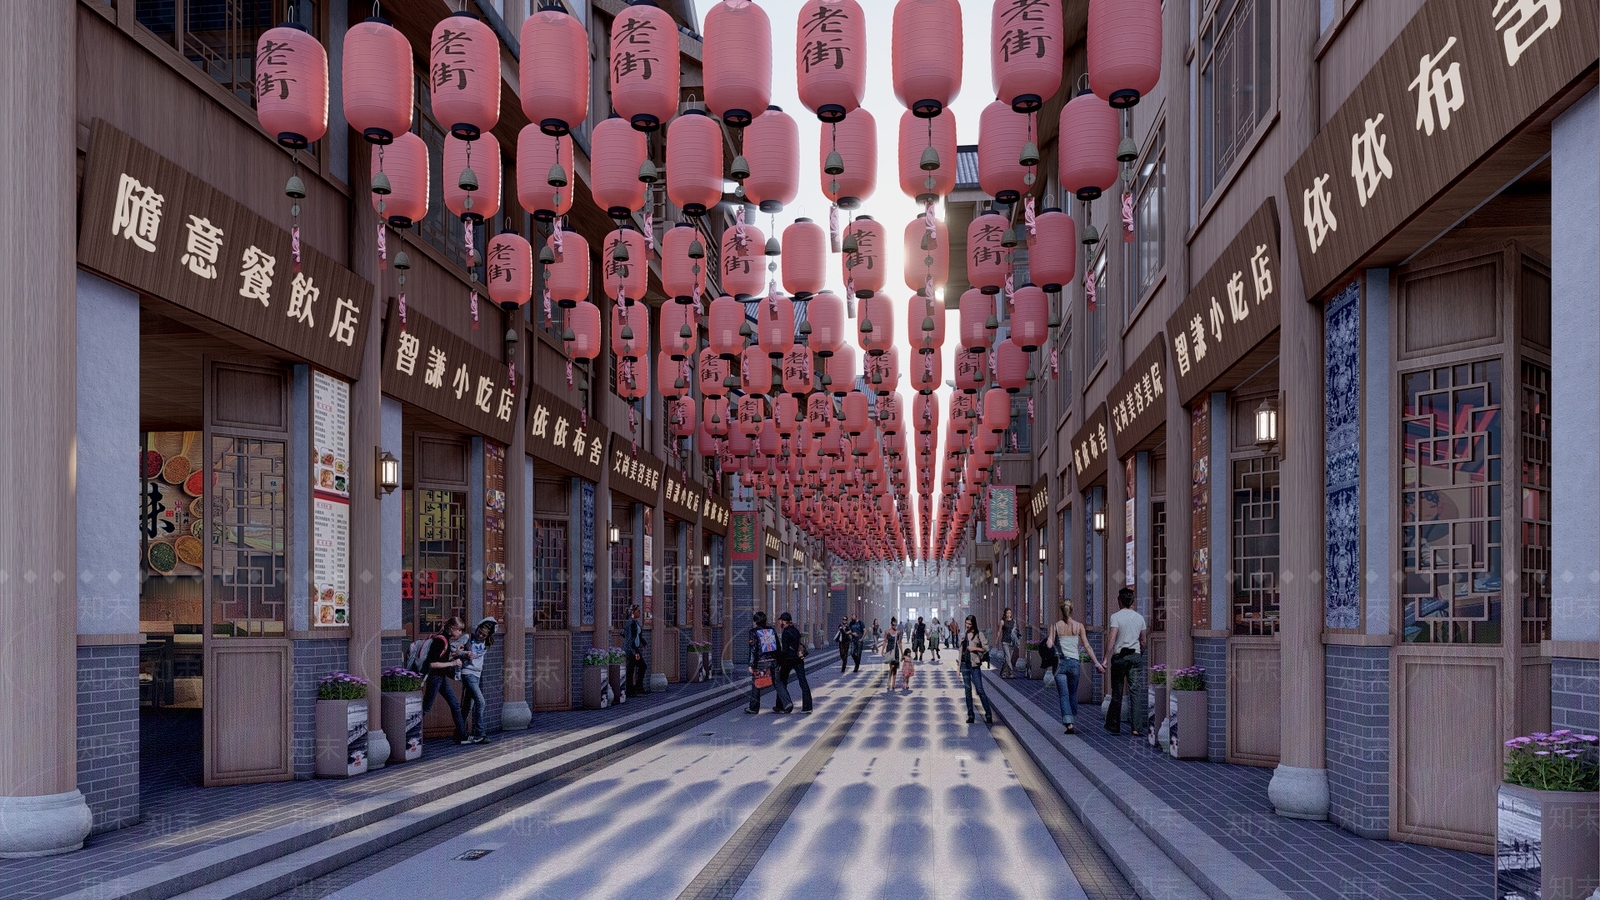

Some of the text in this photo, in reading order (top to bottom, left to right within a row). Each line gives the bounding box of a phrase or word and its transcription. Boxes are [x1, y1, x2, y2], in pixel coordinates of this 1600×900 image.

[432, 29, 475, 93] 老街
[613, 18, 660, 83] 老街
[801, 6, 851, 73] 老街
[999, 0, 1052, 62] 老街
[256, 40, 297, 103] 老街
[111, 172, 361, 347] 隨意餐飲店
[488, 243, 517, 284] 老街
[846, 229, 877, 270] 老街
[973, 224, 1006, 267] 老街
[1174, 243, 1273, 377] 智謙小吃店
[396, 331, 515, 423] 智謙小吃店
[701, 354, 721, 382] 老街
[532, 404, 602, 466] 依依布舍
[809, 399, 825, 423] 老街
[952, 396, 970, 420] 老街
